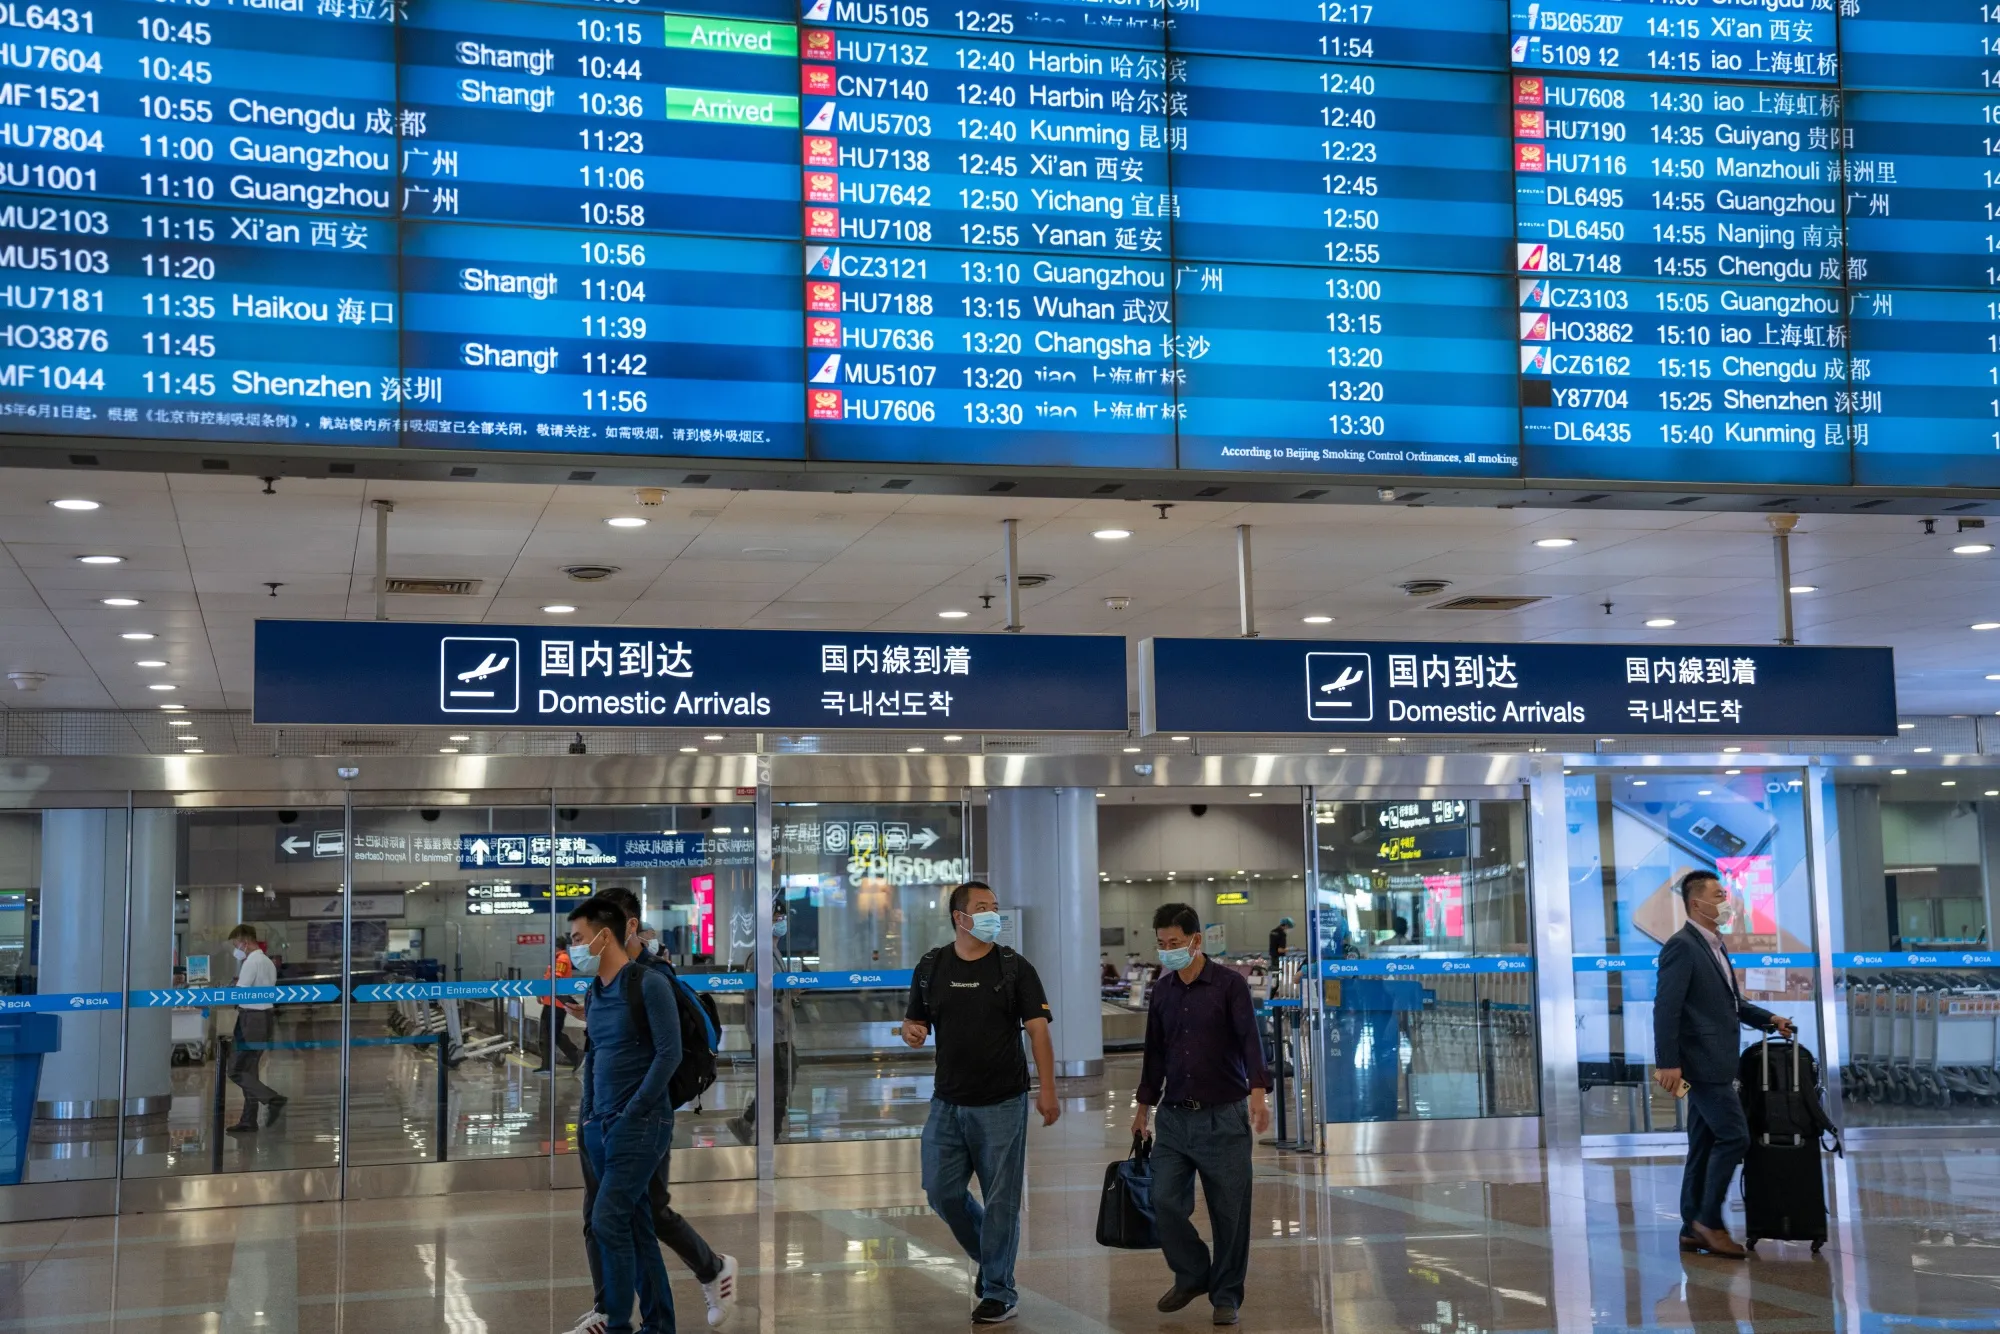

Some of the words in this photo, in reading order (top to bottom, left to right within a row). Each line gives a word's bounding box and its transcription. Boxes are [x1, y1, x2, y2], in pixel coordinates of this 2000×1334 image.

[835, 3, 929, 28] MU5105
[1646, 17, 1700, 39] 14:15
[1711, 16, 1763, 39] Xi'an
[1768, 19, 1813, 43] 西安
[137, 16, 212, 46] 10:45
[690, 25, 772, 51] Arrived
[836, 39, 929, 67] HU713Z
[955, 48, 1015, 73] 12:40
[1028, 49, 1103, 75] Harbin
[138, 55, 213, 85] 10:45
[690, 98, 774, 123] Arrived
[837, 75, 929, 102] CN7140
[956, 83, 1016, 108] 12:40
[1029, 84, 1104, 110] Harbin
[1544, 86, 1626, 109] HU7608
[1650, 91, 1703, 113] 14:30
[139, 95, 213, 123] 10:55
[228, 97, 355, 134] Chengdu
[838, 110, 932, 137] MU5703
[957, 118, 1017, 143] 12:40
[1030, 118, 1130, 151] Kunming
[1545, 119, 1626, 142] HU7190
[1715, 123, 1801, 153] Guiyang
[229, 136, 389, 172] Guangzhou
[402, 147, 458, 178] 广州
[579, 165, 645, 191] 11:06
[838, 146, 931, 172] HU7138
[958, 153, 1018, 177] 12:45
[1030, 153, 1087, 178] Xi'an
[1094, 156, 1143, 183] 西安
[1546, 152, 1627, 176] HU7116
[1651, 157, 1705, 179] 14:50
[1716, 156, 1820, 180] Manzhouli
[229, 174, 389, 210] Guangzhou
[402, 184, 459, 215] 广州
[580, 201, 645, 227] 10:58
[839, 181, 931, 207] HU7642
[959, 188, 1019, 212] 12:50
[1030, 188, 1124, 220] Yichang
[1131, 191, 1181, 218] 宜昌
[1546, 185, 1624, 209] DL6495
[1716, 189, 1835, 217] Guangzhou
[1846, 192, 1889, 217] 广州
[0, 205, 109, 235] MU2103
[230, 216, 300, 243] Xi'an
[310, 221, 368, 250] 西安
[580, 241, 646, 267] 10:56
[840, 217, 932, 242] HU7108
[959, 223, 1020, 247] 12:55
[1031, 223, 1107, 248] Yanan
[1114, 226, 1163, 252] 延安
[1547, 218, 1625, 241] DL6450
[1718, 222, 1795, 250] Nanjing
[0, 245, 110, 274] MU5103
[581, 278, 646, 303] 11:04
[840, 255, 927, 280] CZ3121
[960, 261, 1021, 285] 13:10
[1033, 260, 1165, 291] Guangzhou
[1175, 265, 1223, 292] 广州
[1548, 251, 1622, 274] 8L7148
[1653, 256, 1707, 278] 14:55
[1718, 255, 1812, 283] Chengdu
[0, 285, 103, 312] HU7181
[232, 293, 328, 322] Haikou
[336, 297, 393, 326] 海口
[581, 315, 647, 340] 11:39
[841, 291, 934, 316] HU7188
[1032, 295, 1115, 320] Wuhan
[1122, 297, 1172, 324] 武汉
[1326, 312, 1382, 335] 13:15
[1550, 289, 1629, 310] CZ3103
[1720, 290, 1839, 318] Guangzhou
[1849, 293, 1892, 317] 广州
[842, 326, 935, 351] HU7636
[1034, 330, 1152, 361] Changsha
[1327, 346, 1383, 369] 13:20
[1551, 322, 1633, 343] HO3862
[1656, 324, 1711, 346] 15:10
[0, 324, 109, 353] HO3876
[582, 352, 647, 376] 11:42
[844, 362, 937, 386] MU5107
[1328, 380, 1384, 402] 13:20
[1551, 355, 1631, 376] CZ6162
[1722, 355, 1817, 383] Chengdu
[0, 364, 106, 391] MF1044
[231, 369, 372, 399] Shenzhen
[582, 388, 648, 413] 11:56
[1551, 388, 1629, 409] Y87704
[1658, 390, 1713, 412] 15:25
[1723, 388, 1828, 411] Shenzhen
[843, 398, 936, 422] HU7606
[1328, 414, 1385, 436] 13:30
[1553, 421, 1632, 443] DL6435
[1725, 422, 1816, 449] Kunming
[1221, 446, 1271, 458] According
[1273, 446, 1284, 457] to
[1285, 447, 1320, 460] Beijing
[1322, 449, 1365, 461] Smoking
[1367, 451, 1403, 461] Control
[1405, 451, 1462, 463] Ordinances,
[1464, 452, 1475, 463] all
[1477, 453, 1518, 465] smoking
[539, 641, 695, 678] 国内到达
[820, 644, 971, 676] 国内線到着
[1389, 653, 1517, 688] 国内到达
[1626, 657, 1756, 685] 国内線到着
[538, 688, 666, 714] Domestic
[674, 689, 770, 715] Arrivals
[820, 690, 953, 716] 국내선도착
[1388, 700, 1496, 723] Domestic
[1502, 701, 1584, 723] Arrivals
[1627, 699, 1742, 723] 국내선도착
[531, 854, 570, 865] Bagage
[576, 853, 617, 864] Inquiries
[1341, 965, 1359, 973] BCIA
[1508, 961, 1526, 969] BCIA
[1608, 960, 1626, 968] BCIA
[1773, 957, 1791, 965] BCIA
[1865, 956, 1883, 964] BCIA
[1919, 955, 1937, 963] BCIA
[1974, 955, 1992, 963] BCIA
[417, 984, 441, 997] 入口
[446, 984, 488, 996] Entrance
[723, 978, 744, 986] BCIA
[800, 976, 819, 984] BCIA
[862, 975, 882, 983] BCIA
[8, 1001, 31, 1009] BCIA
[86, 998, 109, 1006] BCIA
[200, 990, 225, 1002] 入口
[230, 991, 275, 1001] Entrance
